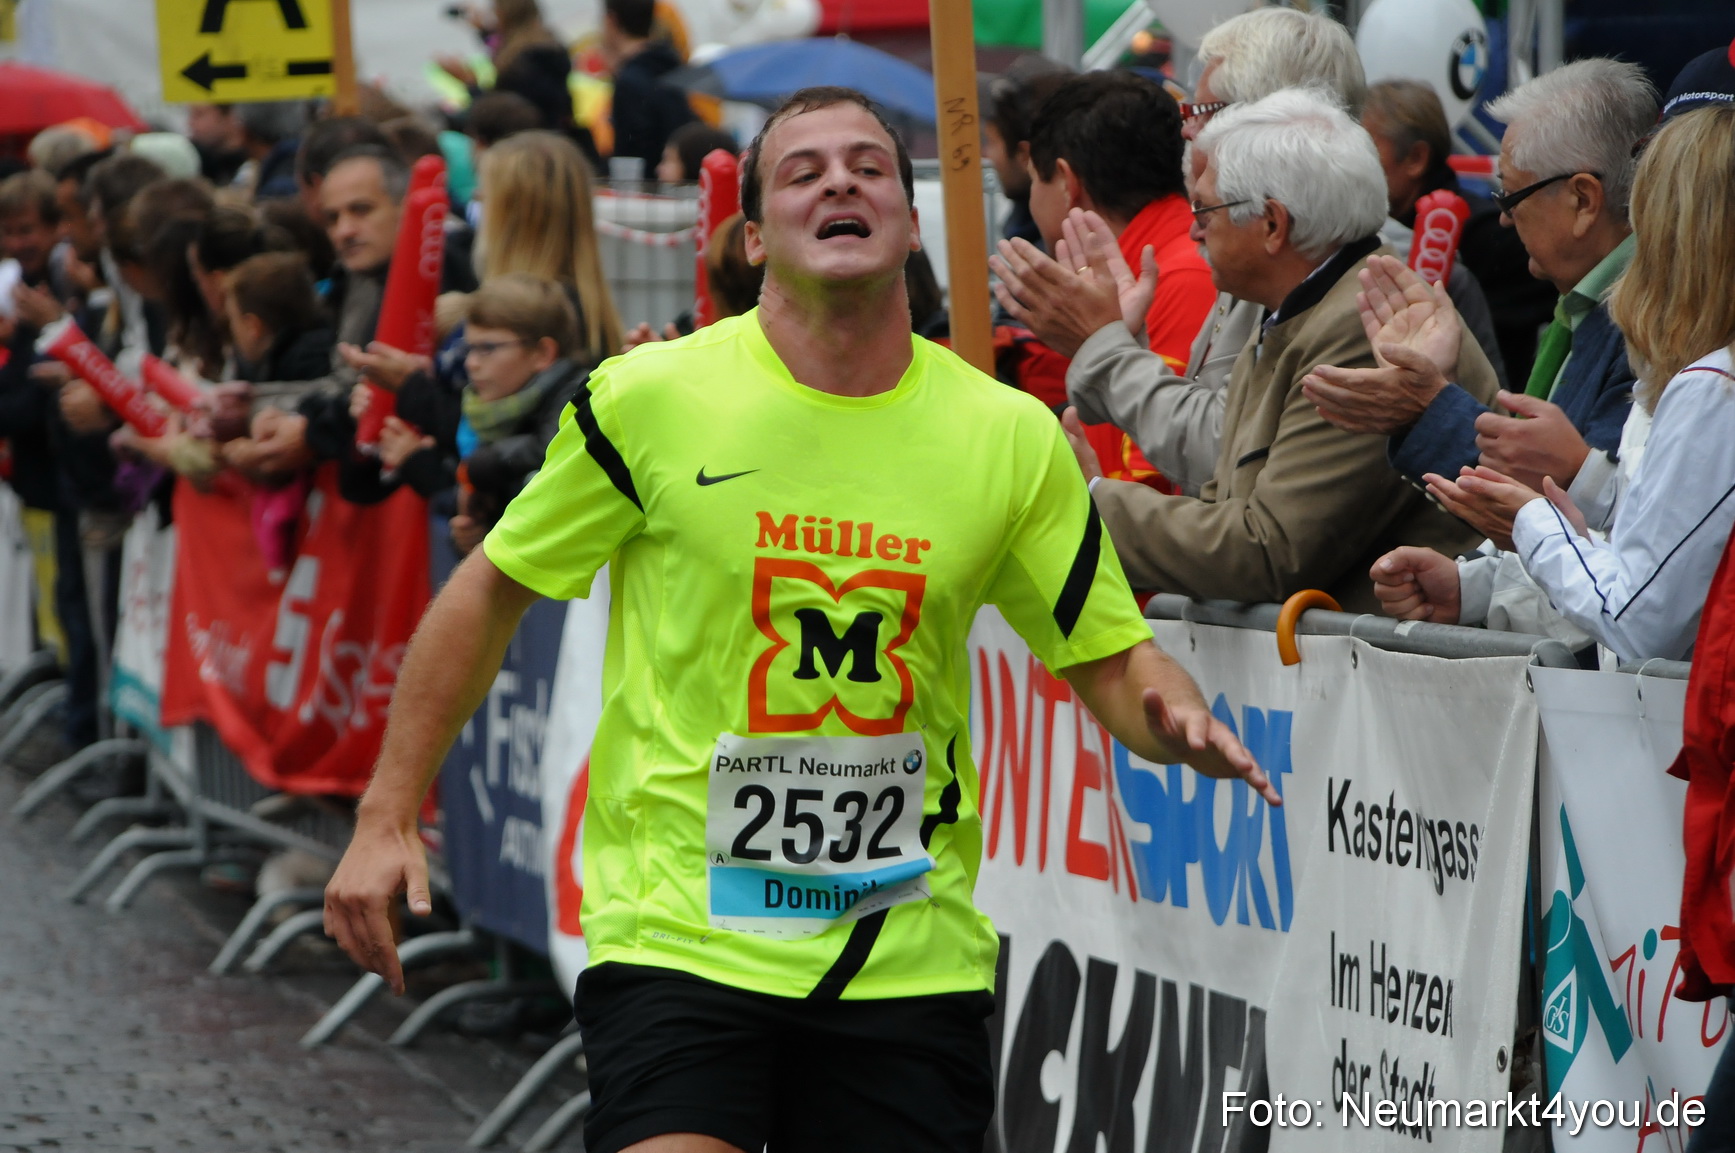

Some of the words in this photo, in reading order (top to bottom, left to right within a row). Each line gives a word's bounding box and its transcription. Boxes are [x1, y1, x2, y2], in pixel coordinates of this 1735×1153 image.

[1678, 91, 1735, 102] Motorsport
[755, 511, 931, 564] Müller
[792, 607, 884, 683] M
[716, 755, 792, 774] PARTL
[799, 756, 896, 778] Neumarkt
[715, 853, 725, 864] A
[731, 784, 905, 865] 2532
[1328, 777, 1485, 896] Kastengass
[1331, 931, 1360, 1013] Im
[1333, 1038, 1371, 1119] der
